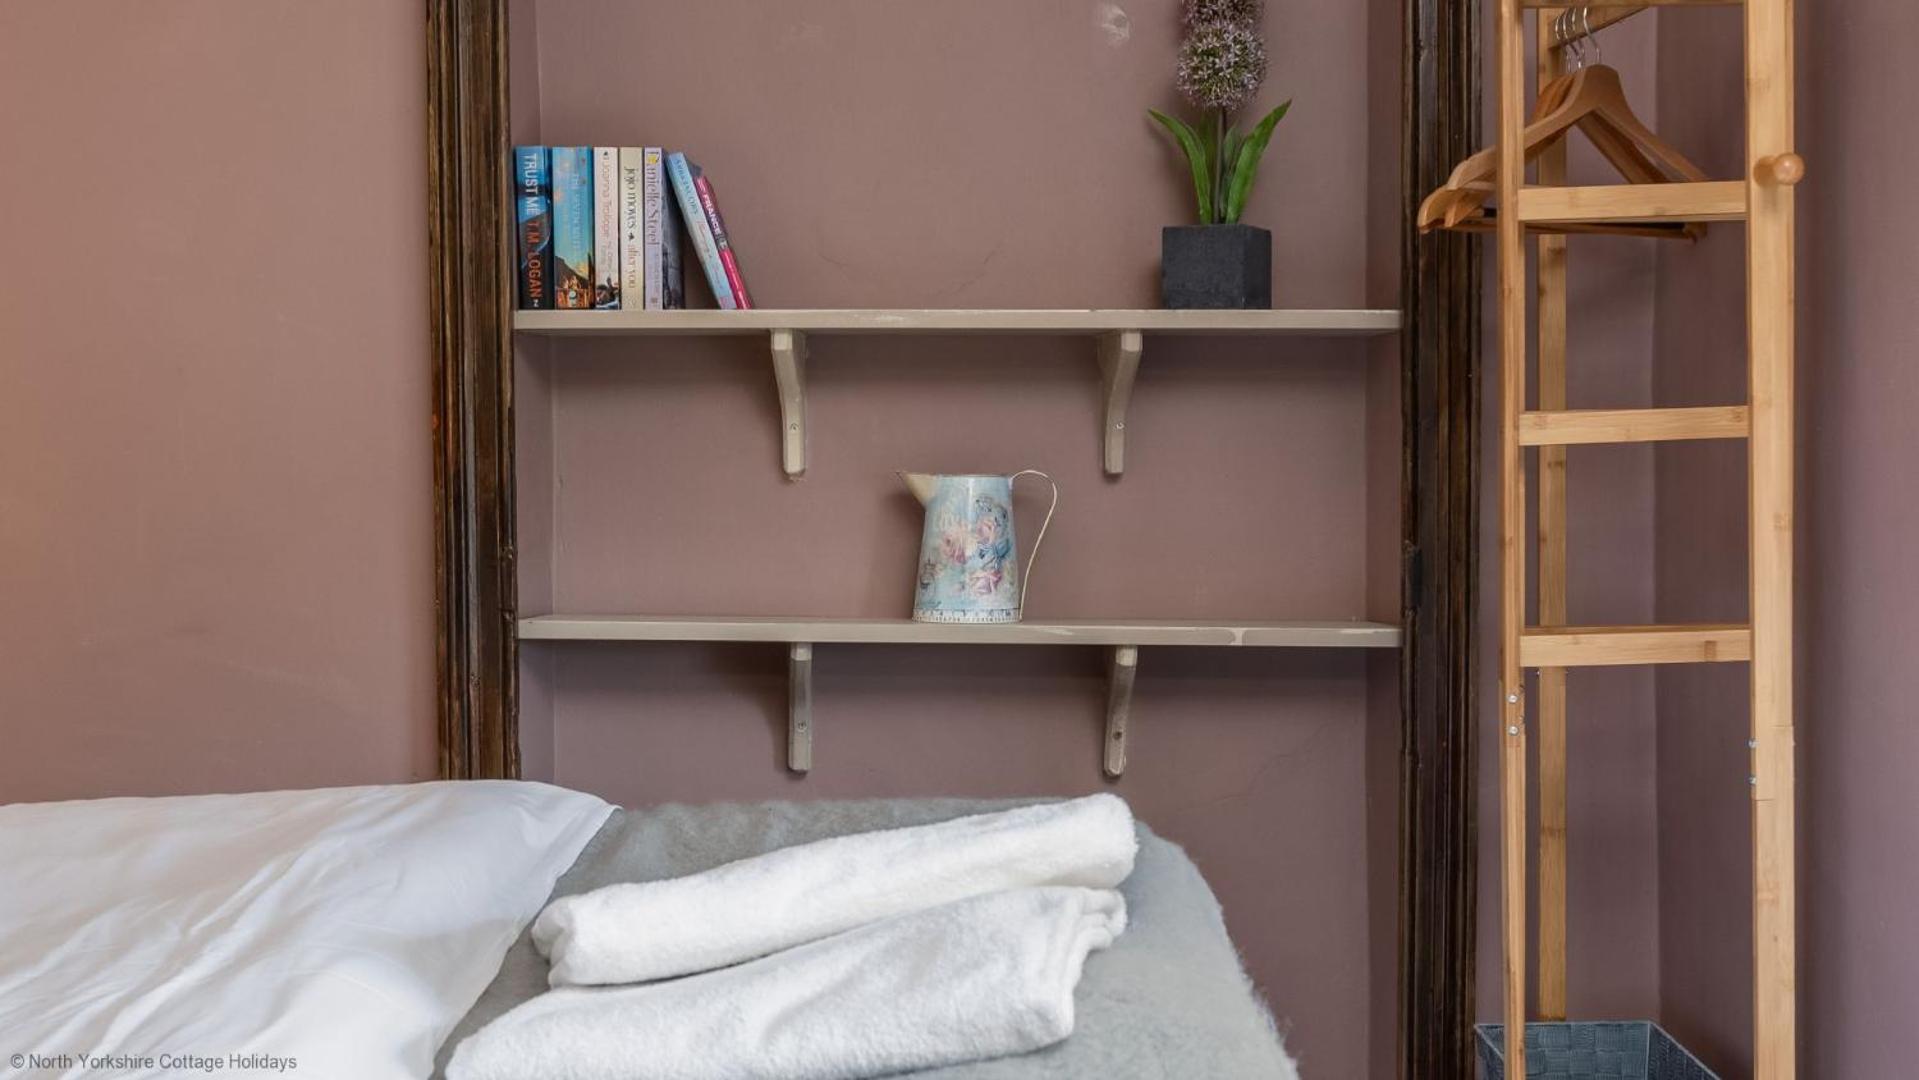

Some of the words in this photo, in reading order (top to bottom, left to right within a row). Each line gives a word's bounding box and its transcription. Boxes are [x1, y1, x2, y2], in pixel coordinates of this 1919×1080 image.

[523, 153, 538, 195] TRUST
[624, 167, 638, 190] jojo
[526, 196, 539, 216] ME
[624, 192, 636, 229] moyes
[647, 209, 660, 246] Steel
[528, 249, 543, 299] LOGAN
[624, 268, 635, 289] you
